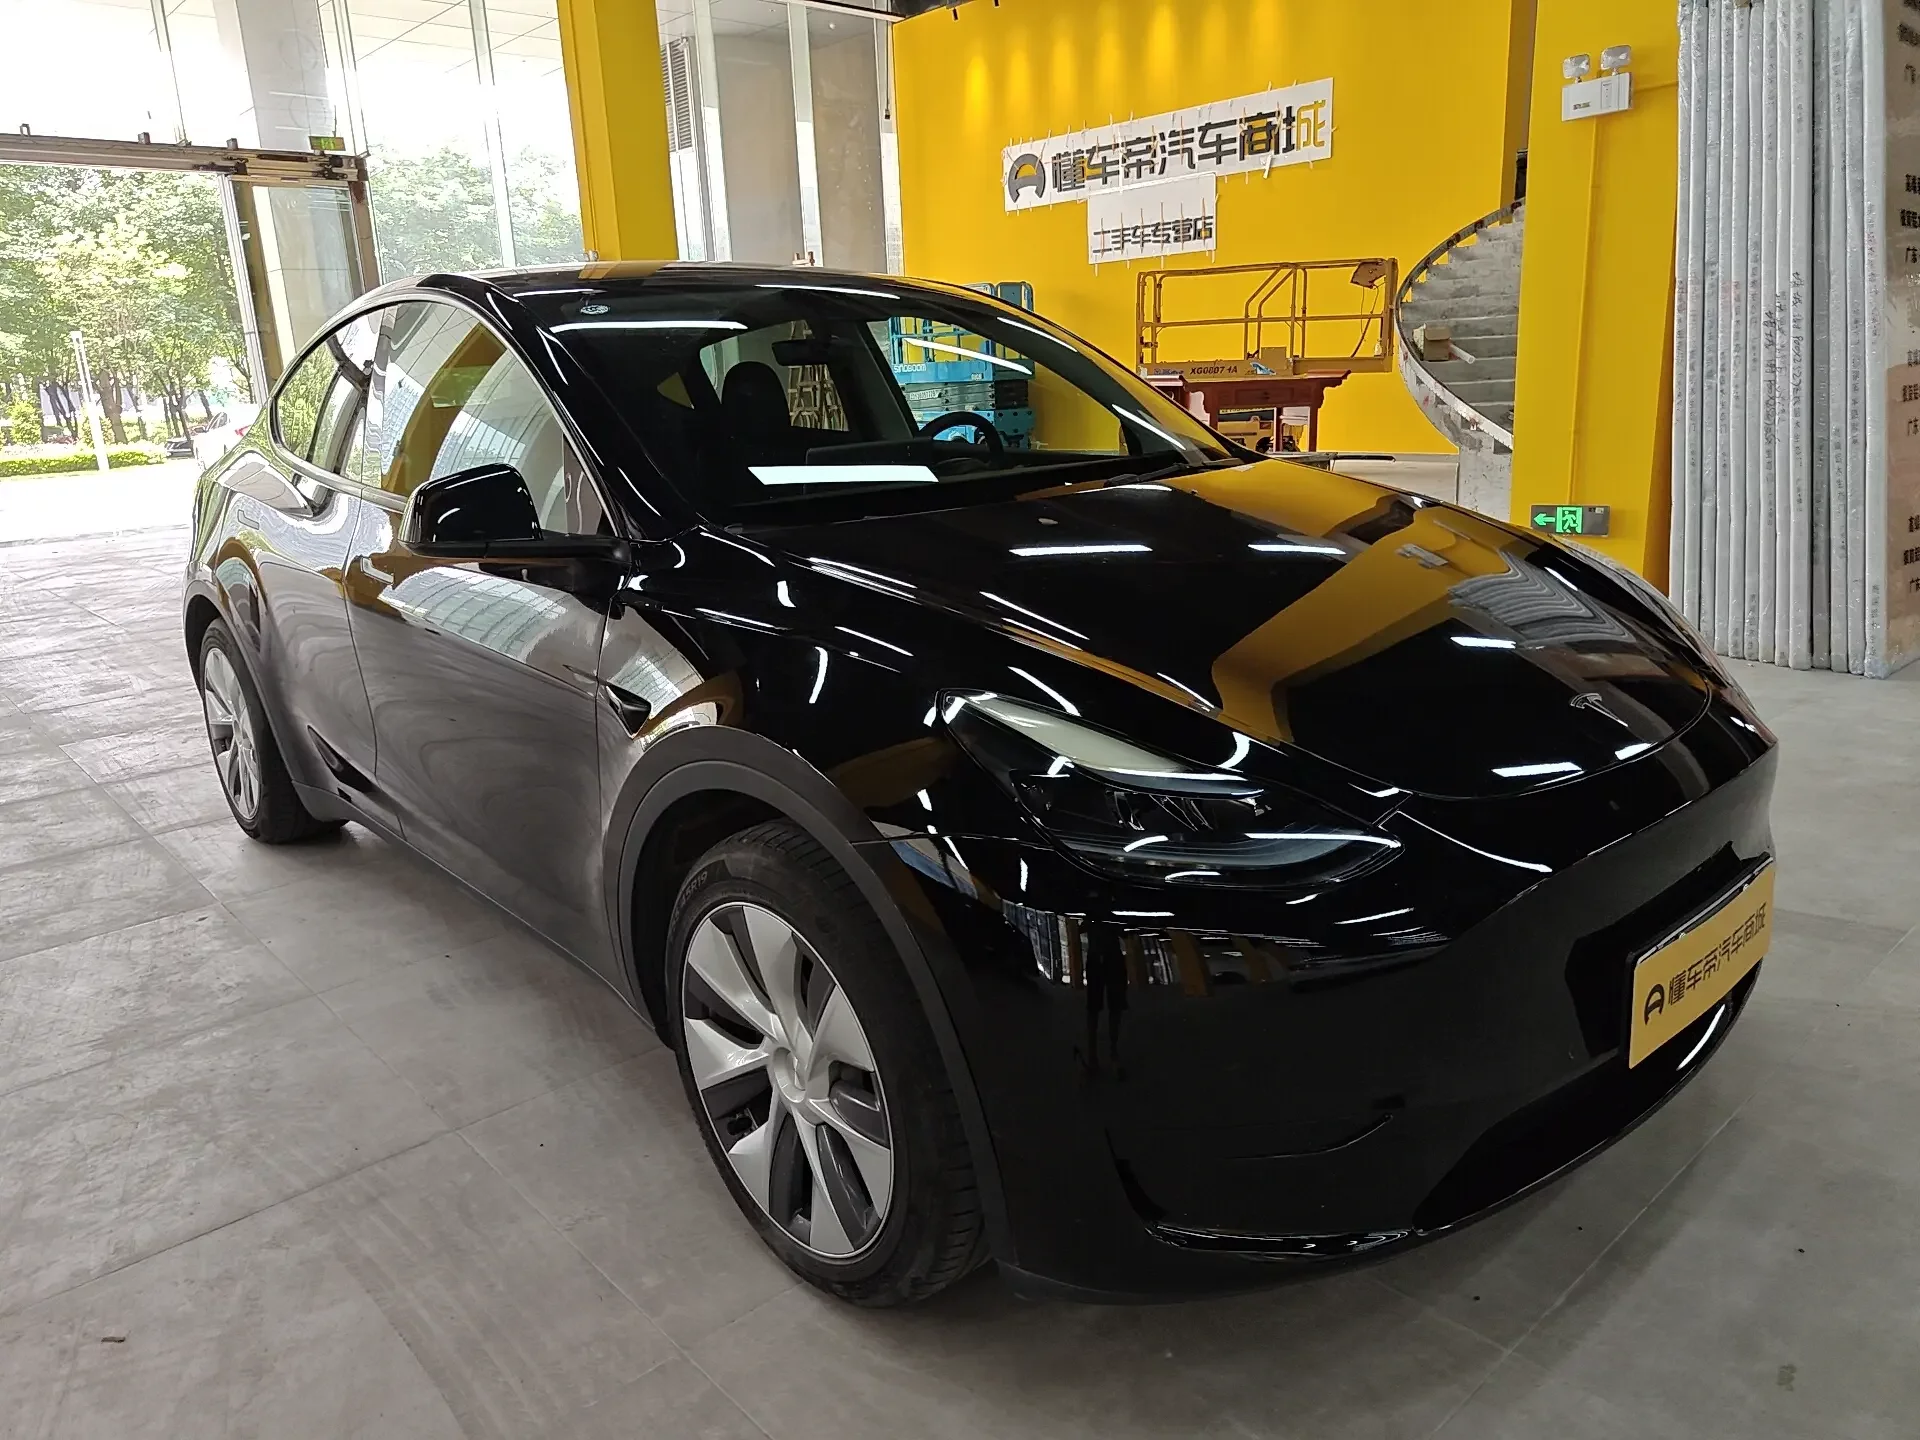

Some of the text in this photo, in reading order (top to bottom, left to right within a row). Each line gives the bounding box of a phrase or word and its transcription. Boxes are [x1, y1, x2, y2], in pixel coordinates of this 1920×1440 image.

[1051, 98, 1328, 193] 懂车帝汽车商城
[1093, 216, 1214, 254] 二手车专营店
[1668, 902, 1767, 1006] 懂车帝汽车商城
